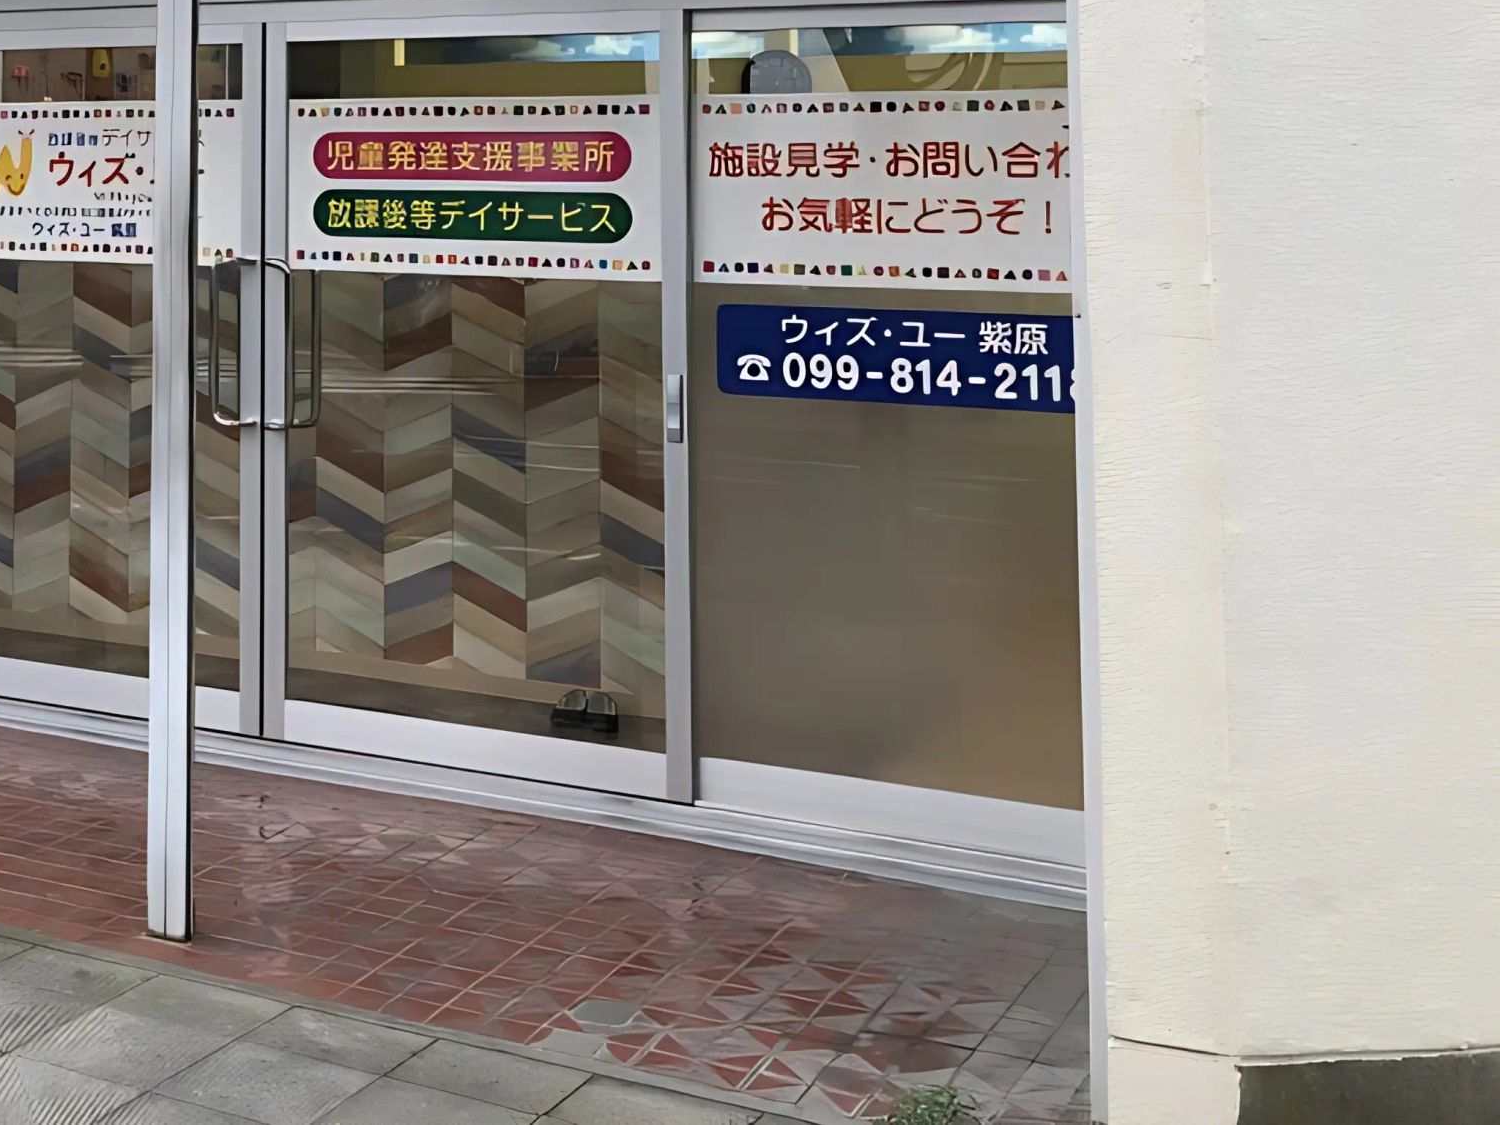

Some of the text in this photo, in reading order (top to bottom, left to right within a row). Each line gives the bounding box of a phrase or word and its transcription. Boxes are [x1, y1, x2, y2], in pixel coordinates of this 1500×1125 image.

[48, 151, 204, 187] ウィズ・
[328, 140, 615, 174] 児童発達支援事業所
[328, 198, 617, 233] 放課後等デイサービス
[781, 314, 1048, 355] ウィズ・ユー 紫原
